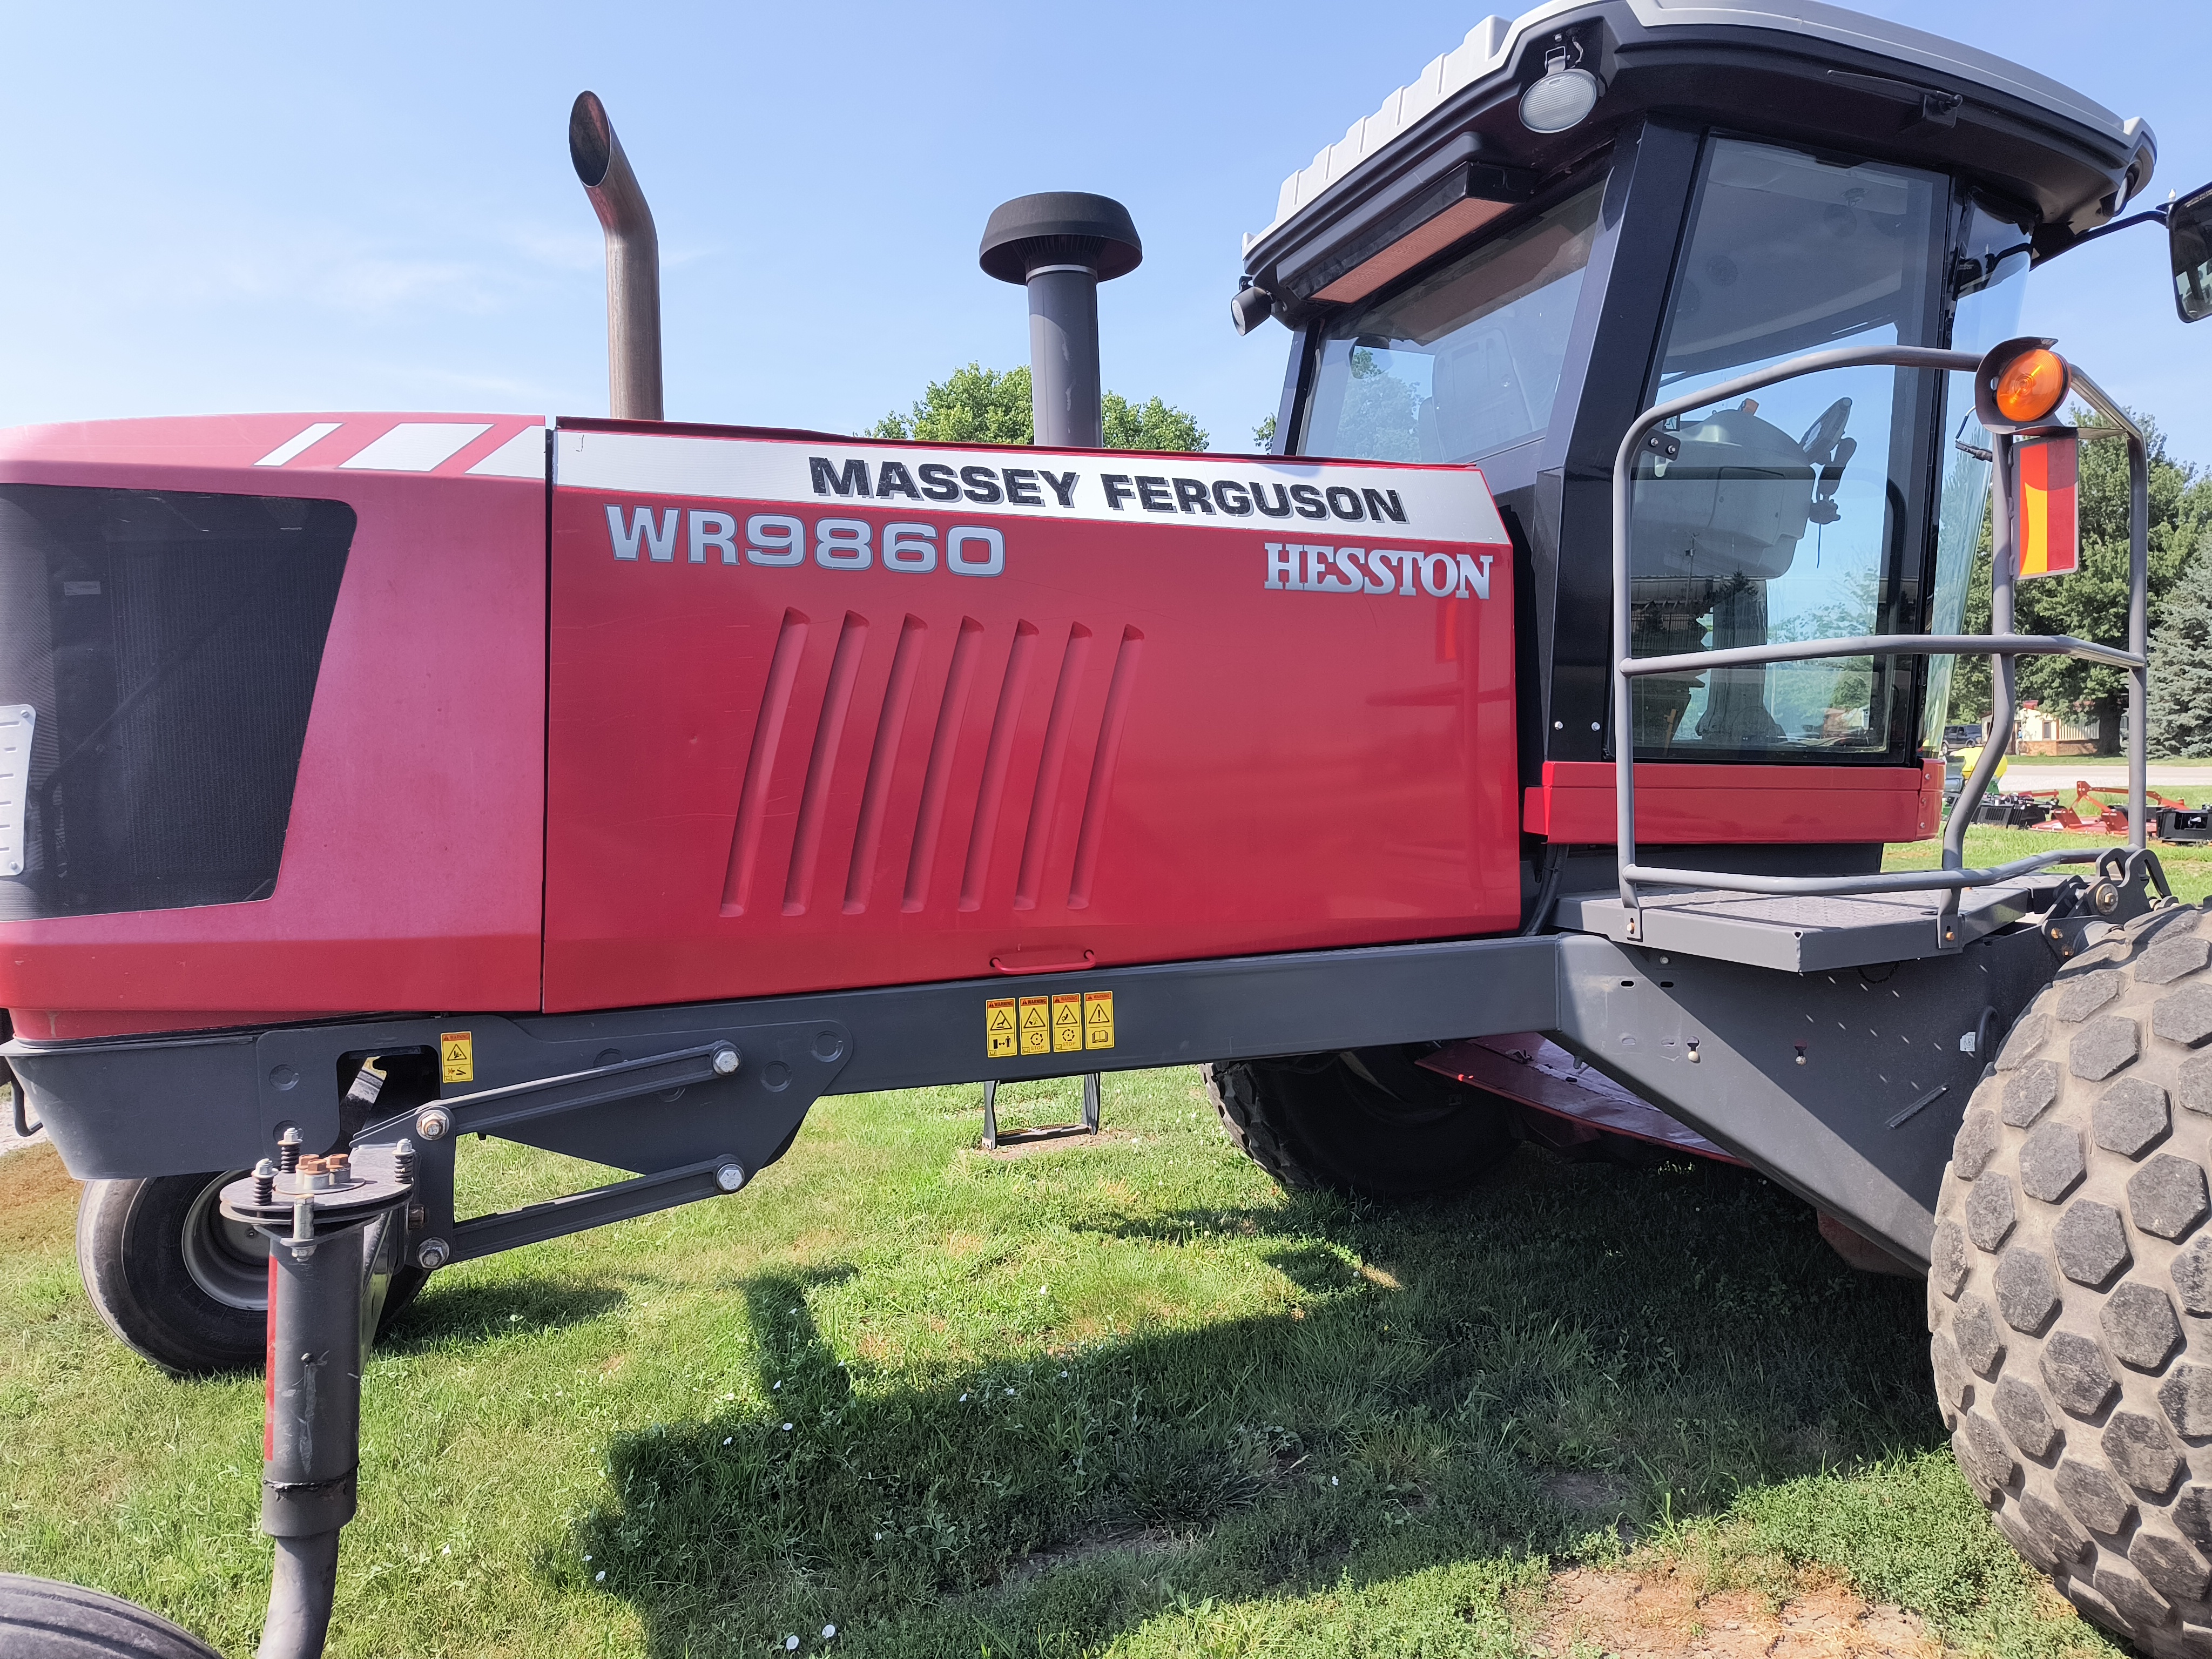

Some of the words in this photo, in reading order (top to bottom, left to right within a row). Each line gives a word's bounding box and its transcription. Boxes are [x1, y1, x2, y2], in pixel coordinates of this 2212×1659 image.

[809, 457, 1079, 508] MASSEY
[1101, 473, 1411, 524] FERGUSON
[604, 504, 1006, 577] WR9860
[1264, 542, 1494, 600] HESSTON
